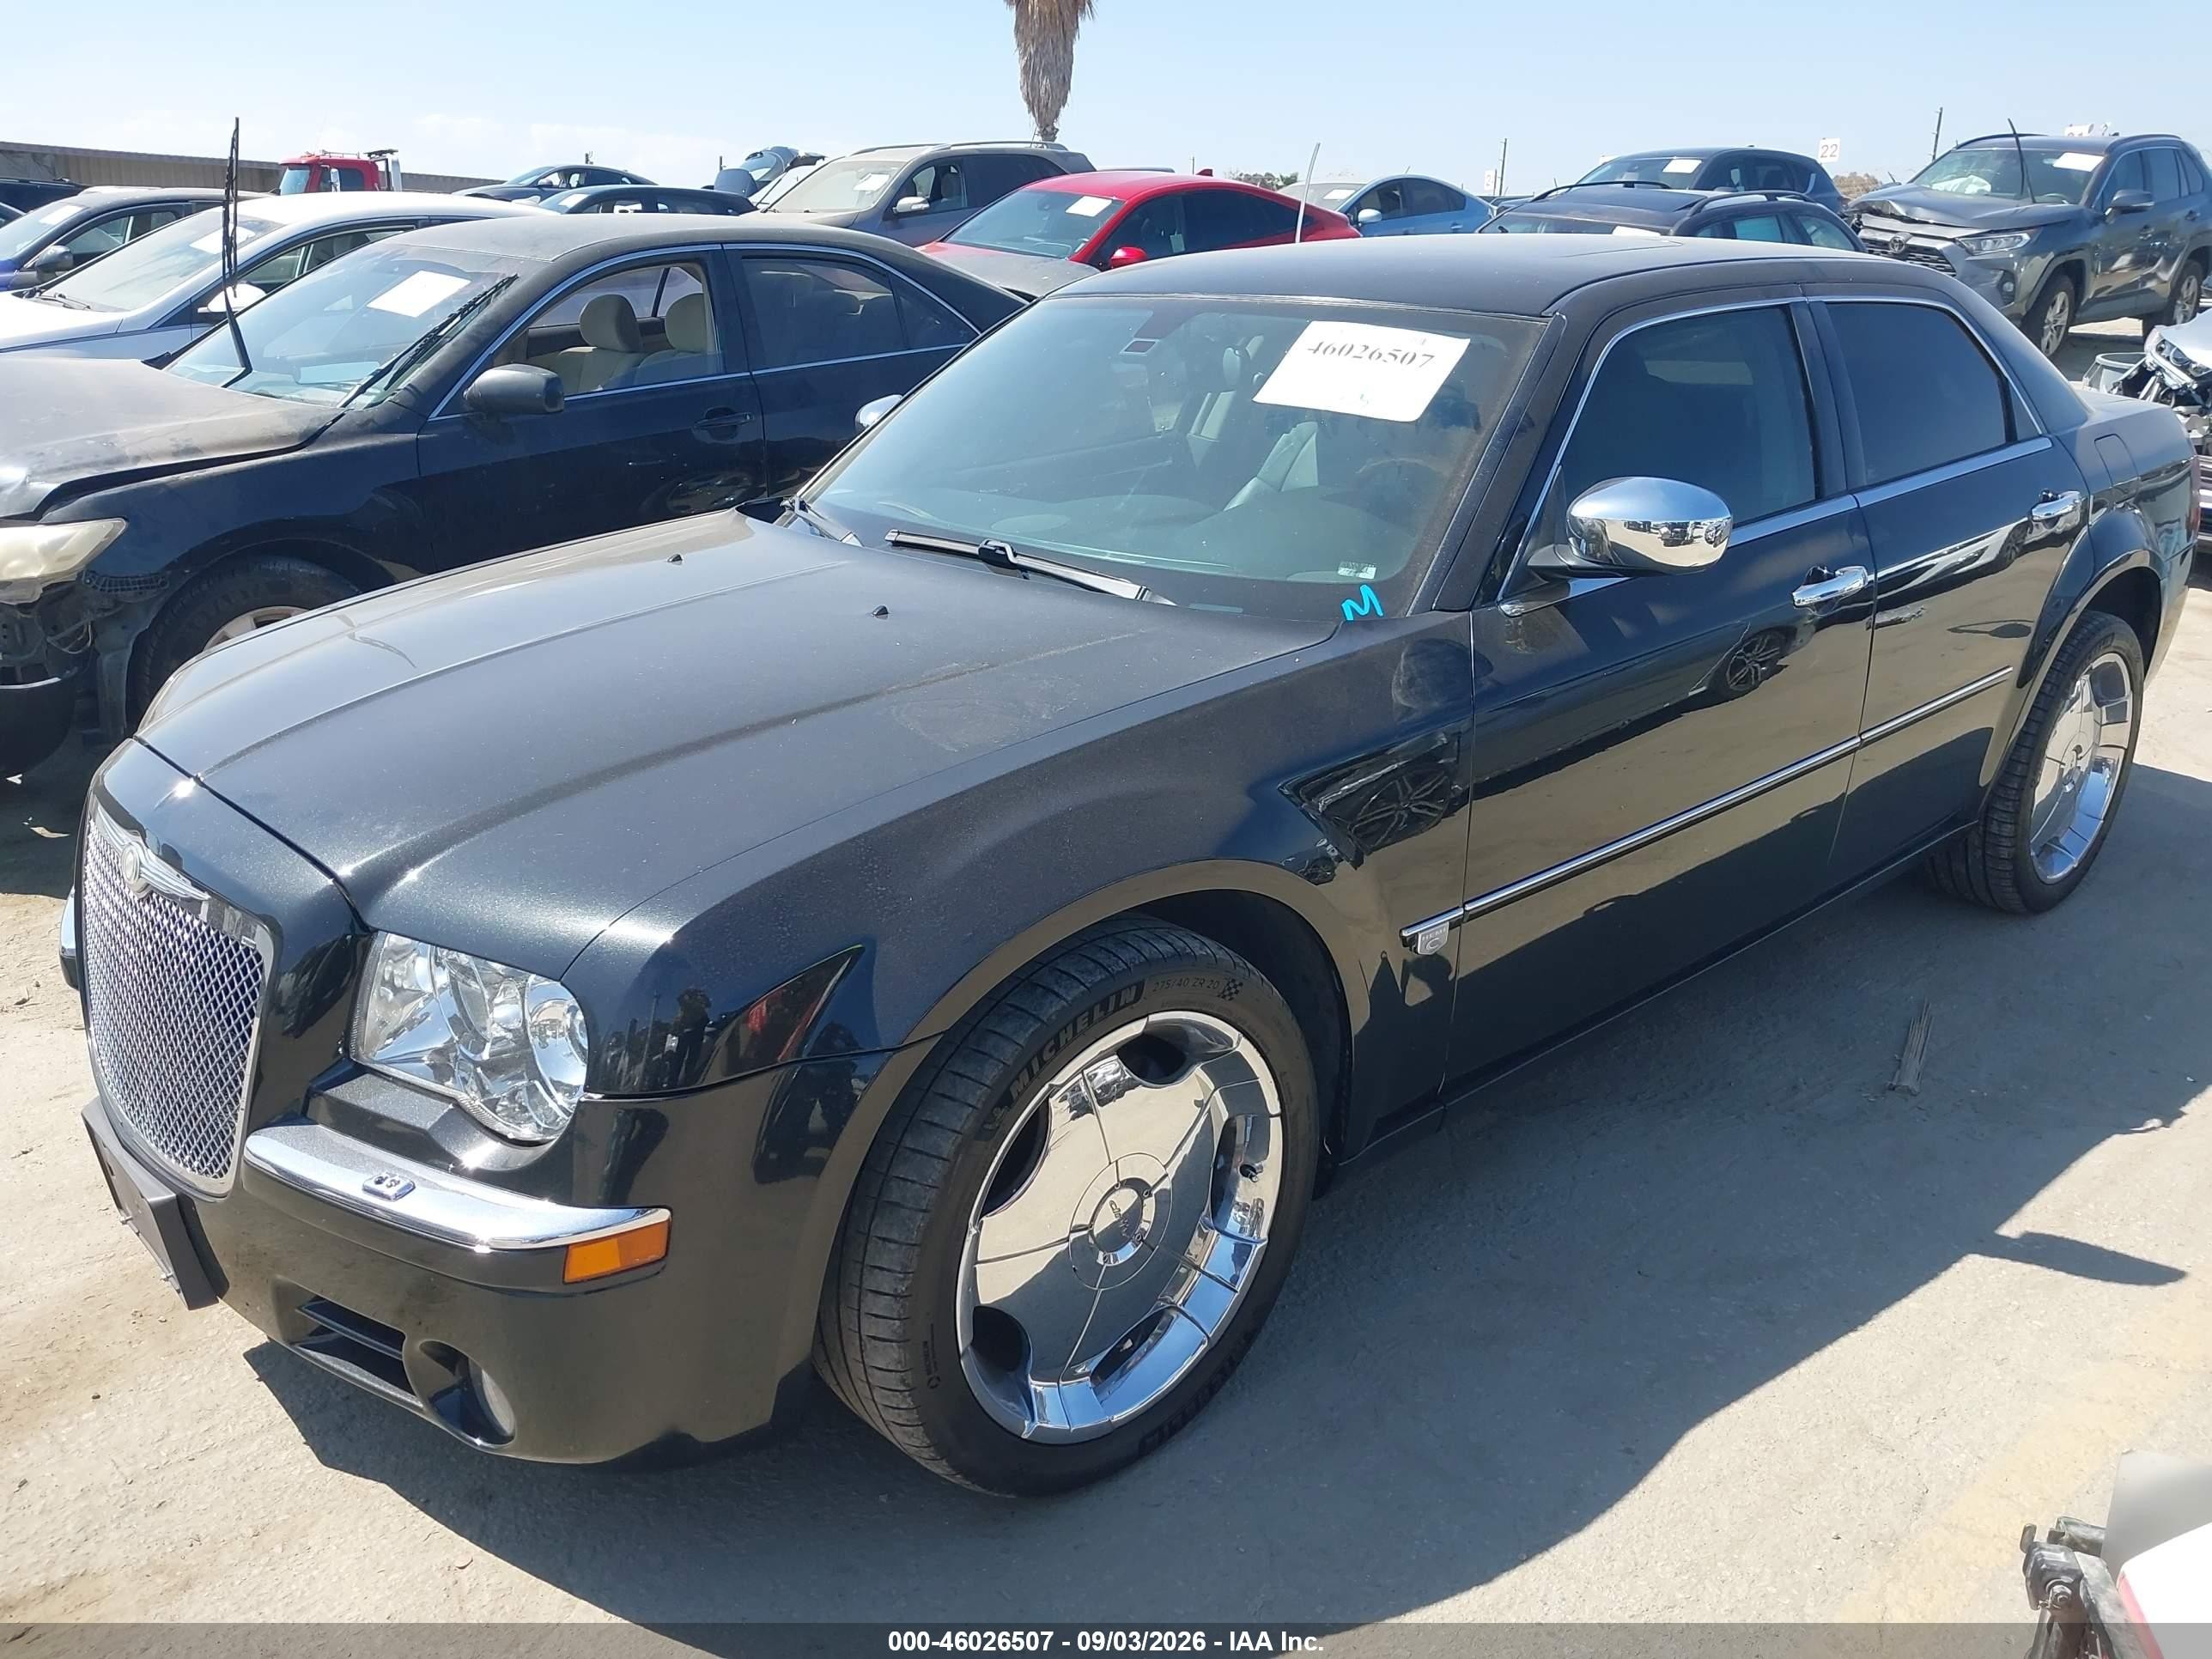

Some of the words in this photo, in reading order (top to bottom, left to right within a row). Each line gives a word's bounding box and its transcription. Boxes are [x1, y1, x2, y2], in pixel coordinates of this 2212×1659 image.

[1820, 143, 1838, 159] 22
[1307, 340, 1436, 368] 46026507
[1341, 584, 1384, 621] M
[1009, 984, 1138, 1101] MICHELIN
